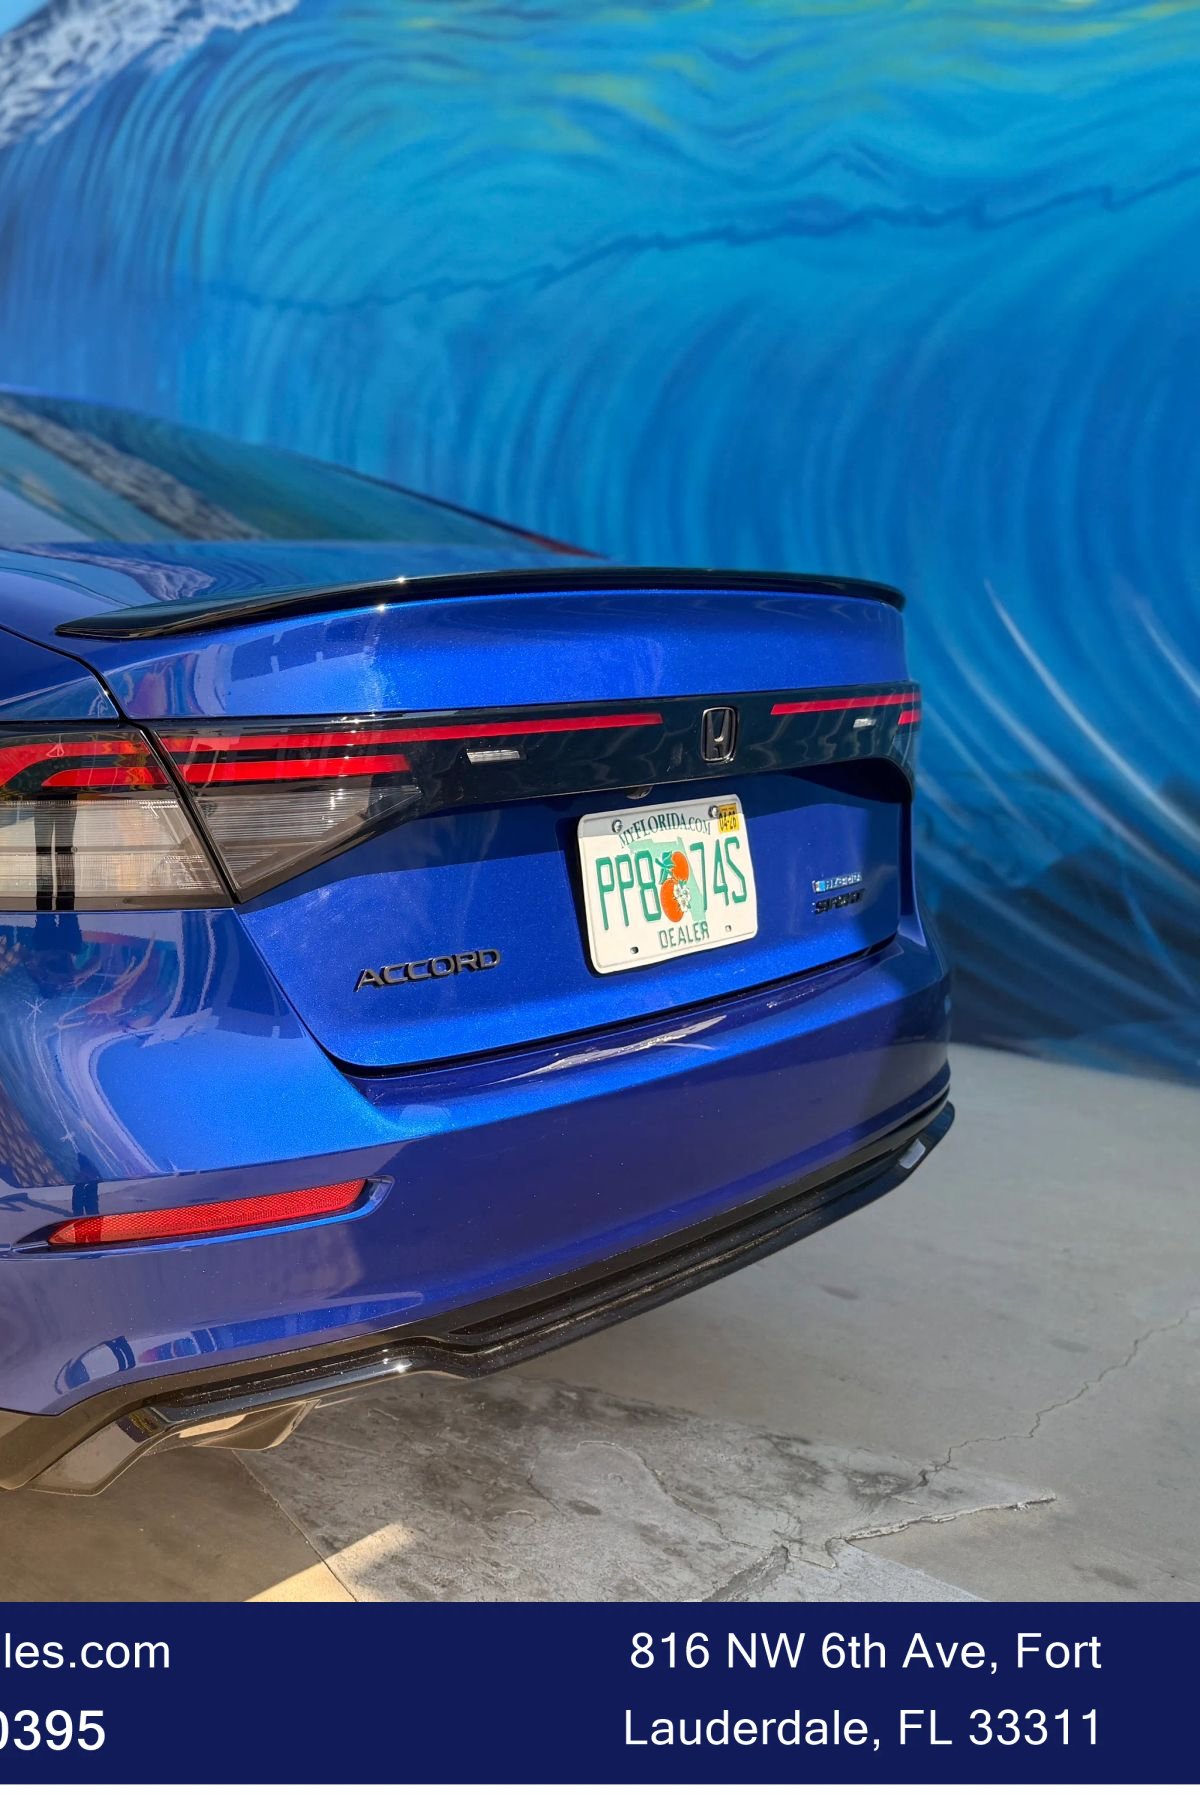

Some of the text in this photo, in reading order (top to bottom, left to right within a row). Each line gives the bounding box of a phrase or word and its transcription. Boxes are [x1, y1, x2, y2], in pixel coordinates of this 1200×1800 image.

[619, 812, 710, 848] MYFLORIDA.COM
[596, 836, 747, 931] PP8 74S
[658, 920, 710, 948] DEALER
[353, 949, 501, 993] ACCORD
